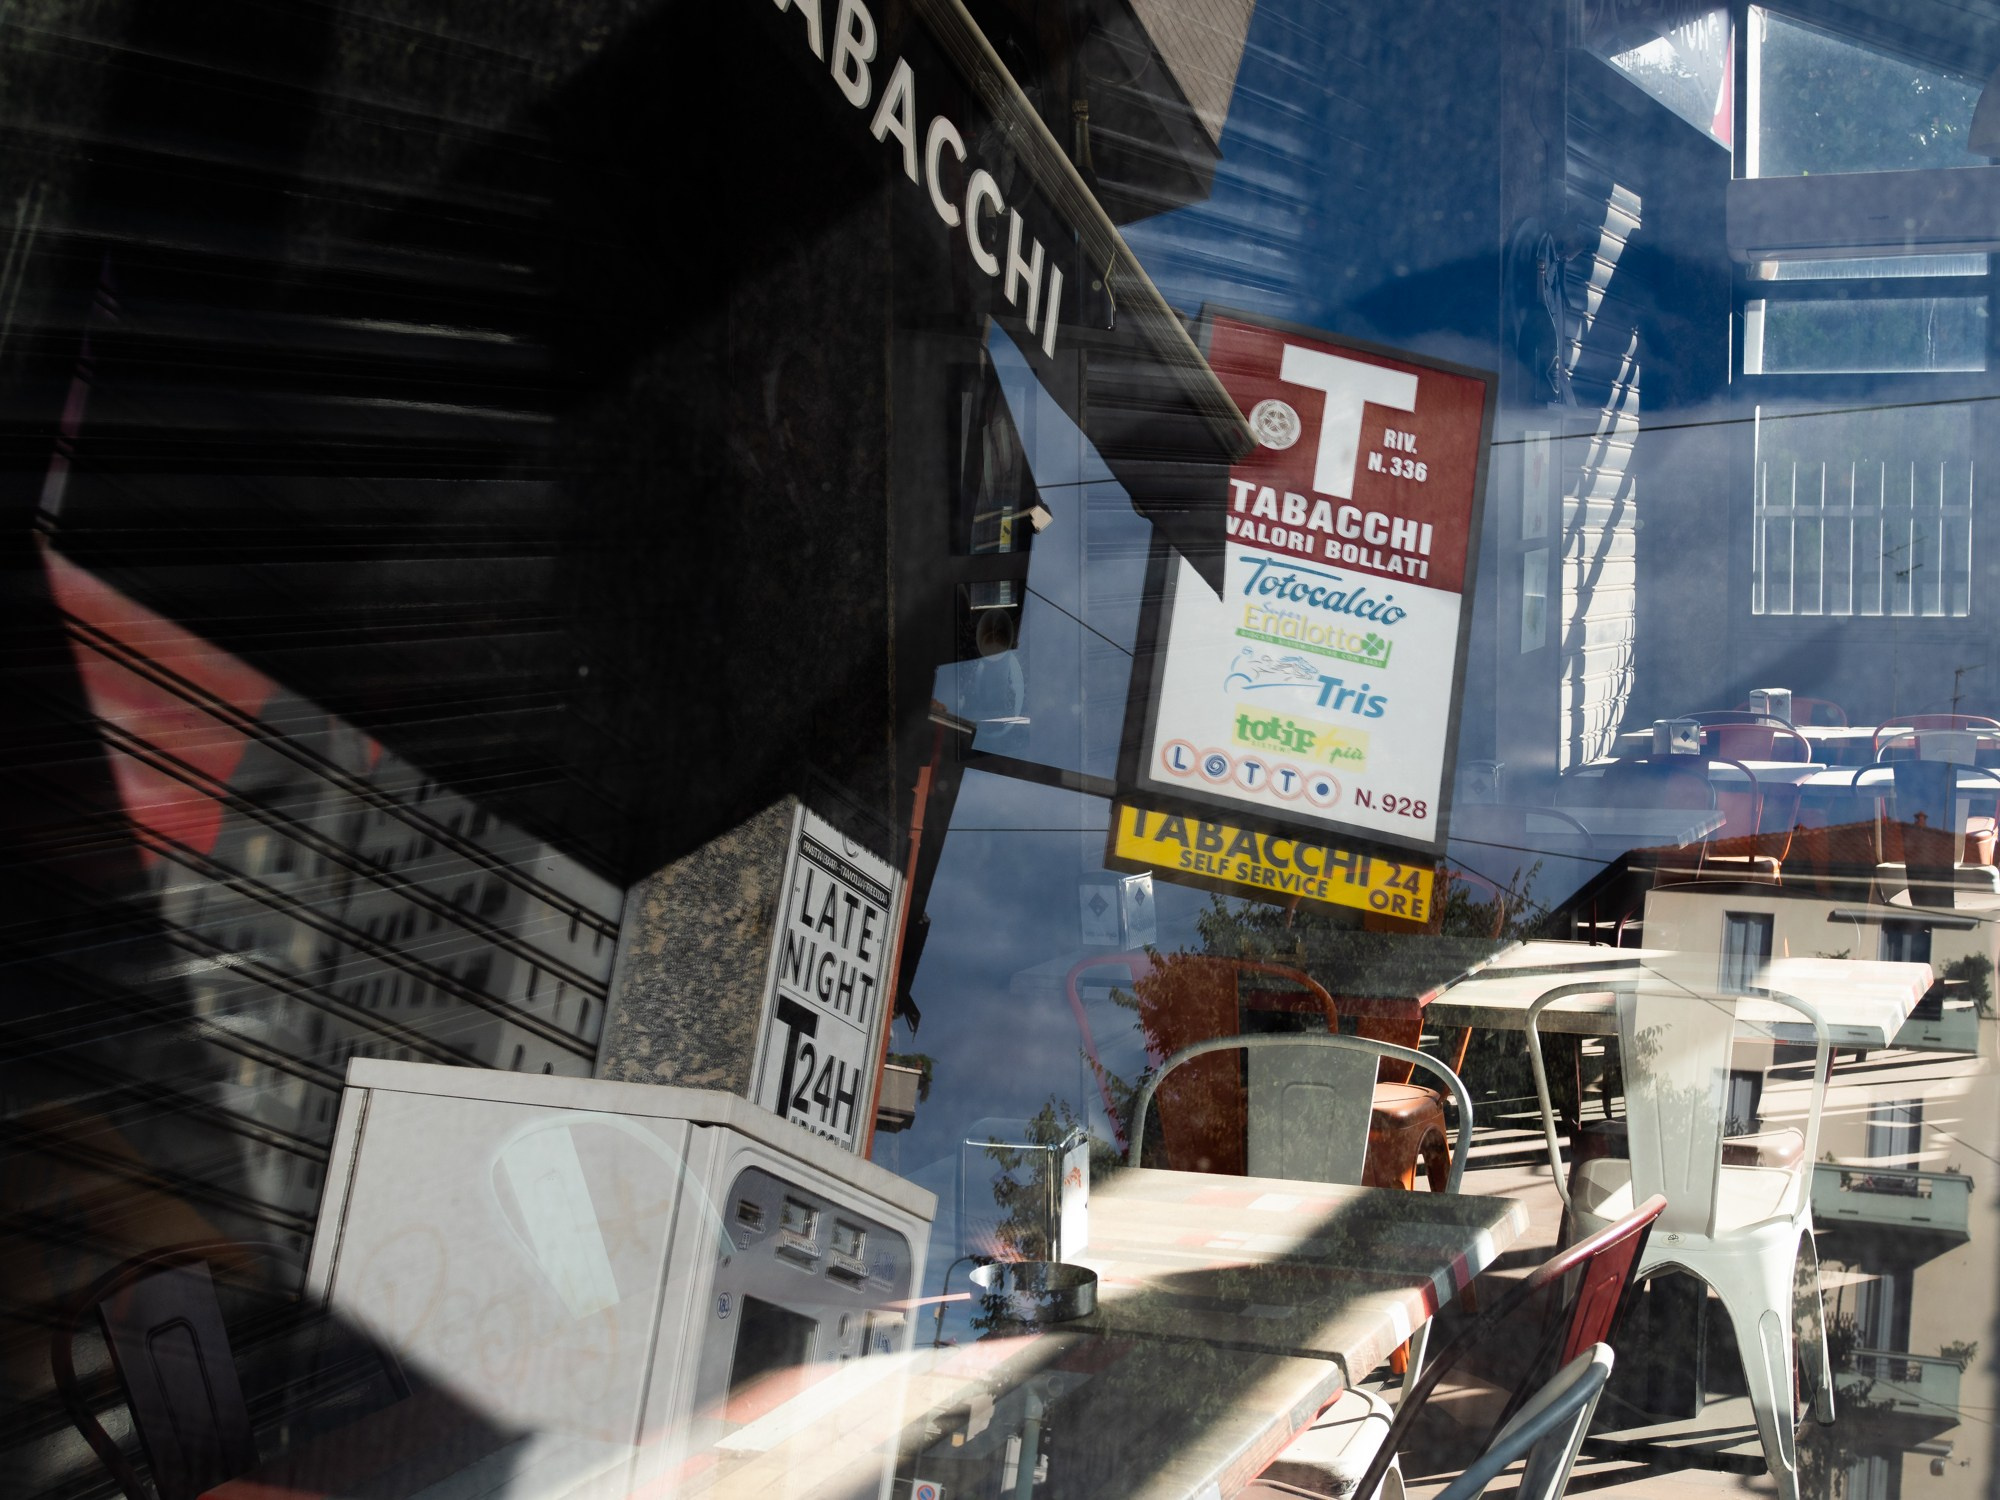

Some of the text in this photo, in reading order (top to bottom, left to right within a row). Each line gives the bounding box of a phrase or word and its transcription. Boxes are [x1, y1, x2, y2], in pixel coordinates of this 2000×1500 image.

[1280, 343, 1419, 500] T
[1383, 428, 1418, 454] RIV.
[1226, 515, 1429, 580] VALORI BOLLATI
[1229, 478, 1433, 556] TABACCHI
[1239, 556, 1407, 626] Totocalcio
[1242, 603, 1364, 653] Enalotto
[1315, 673, 1389, 719] Tris
[1236, 713, 1317, 754] totip
[1179, 849, 1425, 919] SELF SERVICE ORE
[1384, 861, 1420, 896] 24
[799, 867, 878, 963] LATE
[781, 928, 876, 1024] NIGHT
[790, 1042, 861, 1136] 24H
